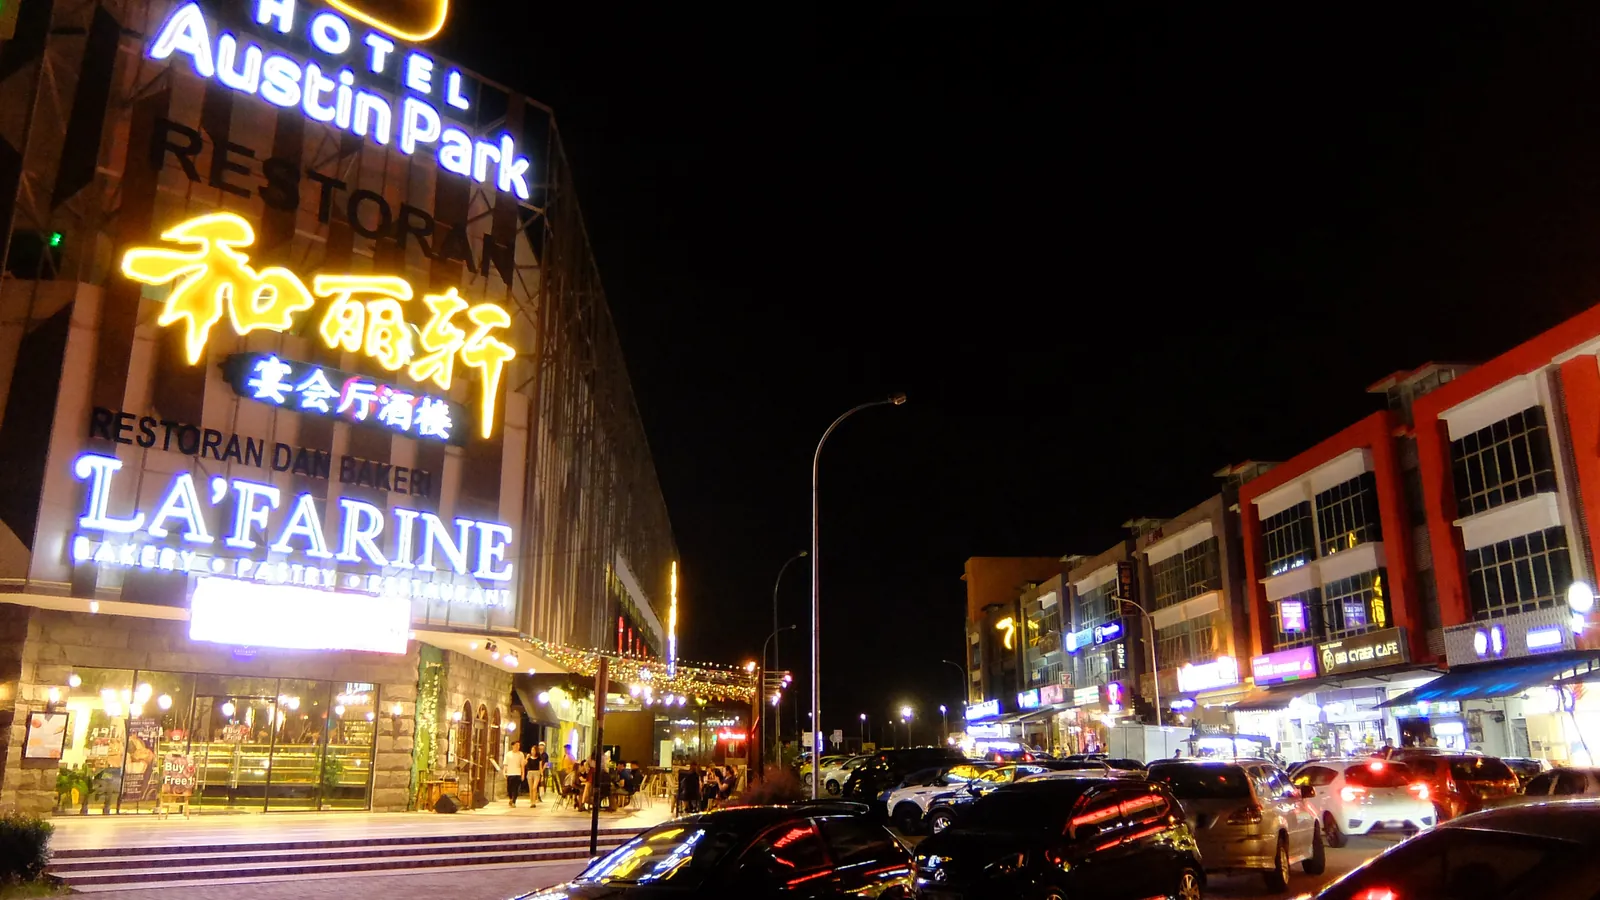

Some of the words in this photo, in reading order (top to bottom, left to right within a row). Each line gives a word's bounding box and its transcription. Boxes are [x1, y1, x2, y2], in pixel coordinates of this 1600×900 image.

[149, 1, 391, 145] Austin
[400, 99, 531, 199] Park
[253, 0, 470, 110] HOTEL
[154, 118, 514, 286] RESTORAN
[121, 211, 516, 439] 和丽轩
[246, 354, 453, 440] 宴会厅酒楼
[89, 406, 265, 468] RESTORAN
[272, 442, 330, 479] DAN
[339, 455, 432, 497] BAKERI
[74, 453, 514, 582] LA'FARINE
[1117, 643, 1125, 669] HOTEL
[1348, 647, 1374, 662] CYBER
[1375, 641, 1399, 657] CAFE
[165, 762, 185, 774] Buy
